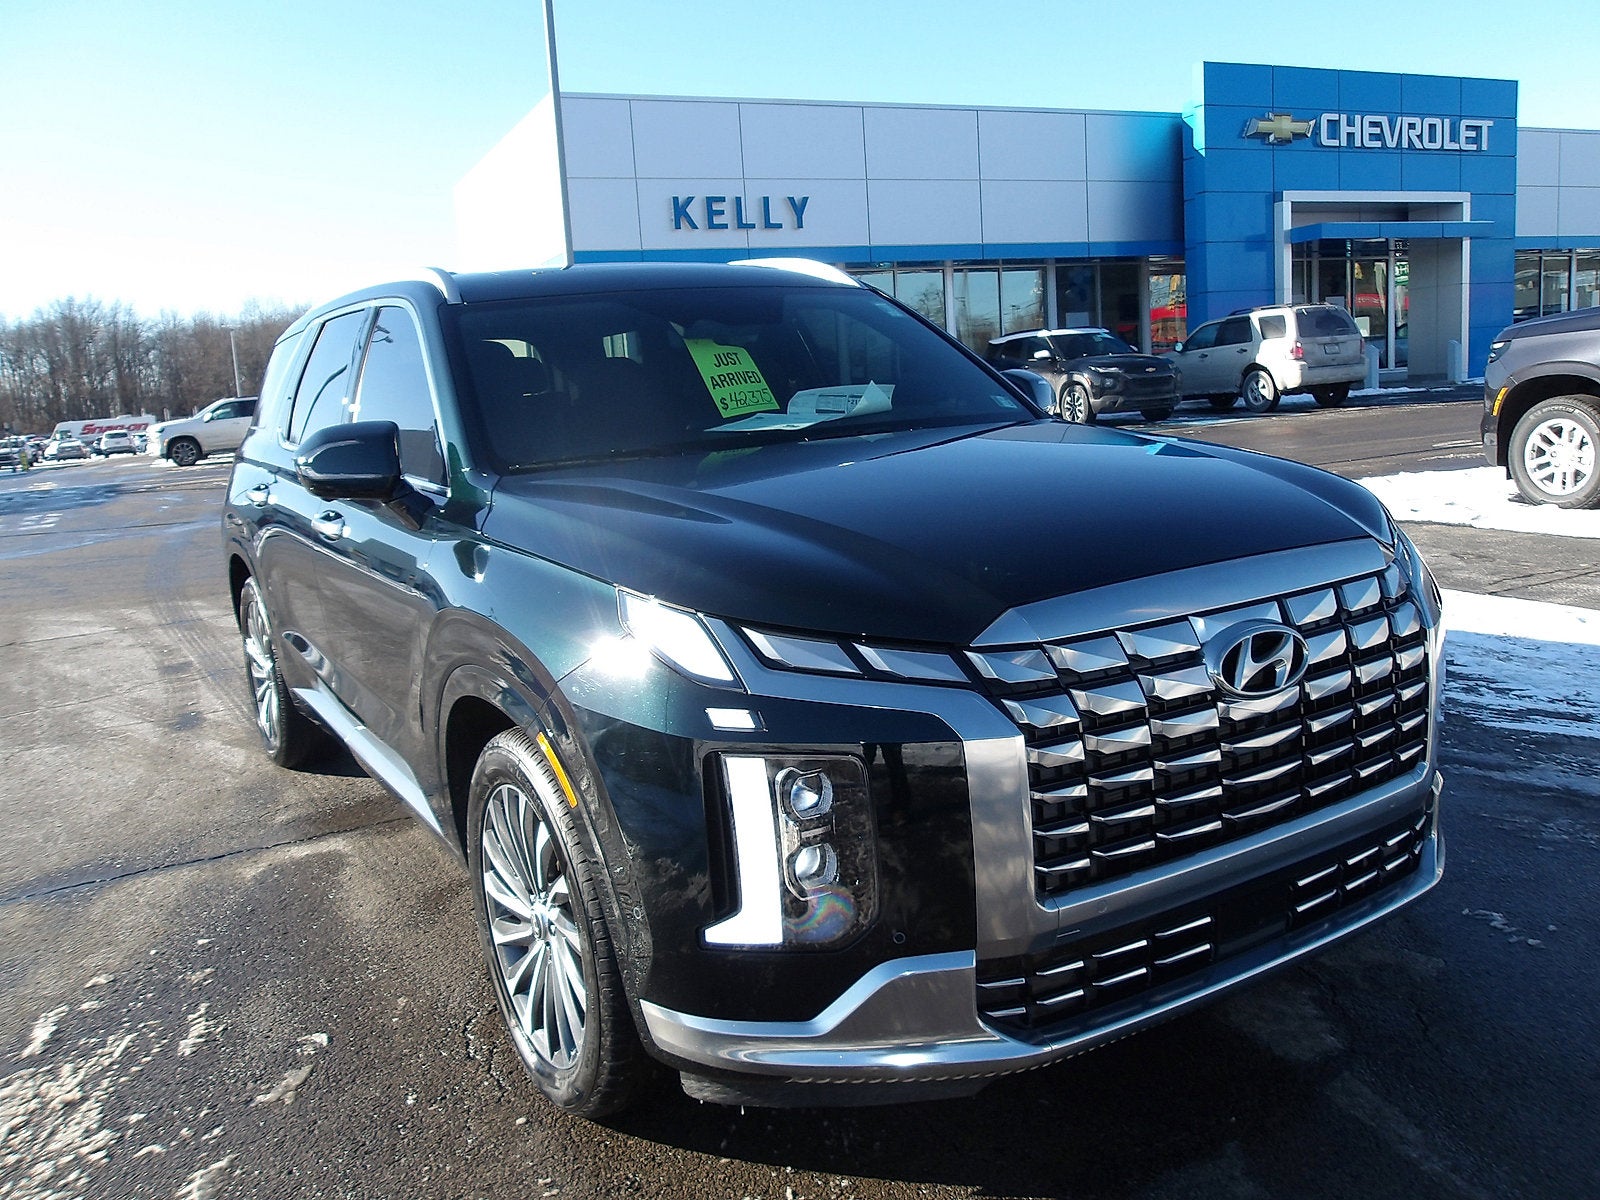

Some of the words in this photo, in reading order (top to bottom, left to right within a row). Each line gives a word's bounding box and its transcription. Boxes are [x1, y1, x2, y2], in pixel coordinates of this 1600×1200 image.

[1318, 112, 1495, 151] CHEVROLET
[671, 195, 810, 230] KELLY
[713, 351, 743, 368] JUST
[709, 370, 763, 390] ARRIVED
